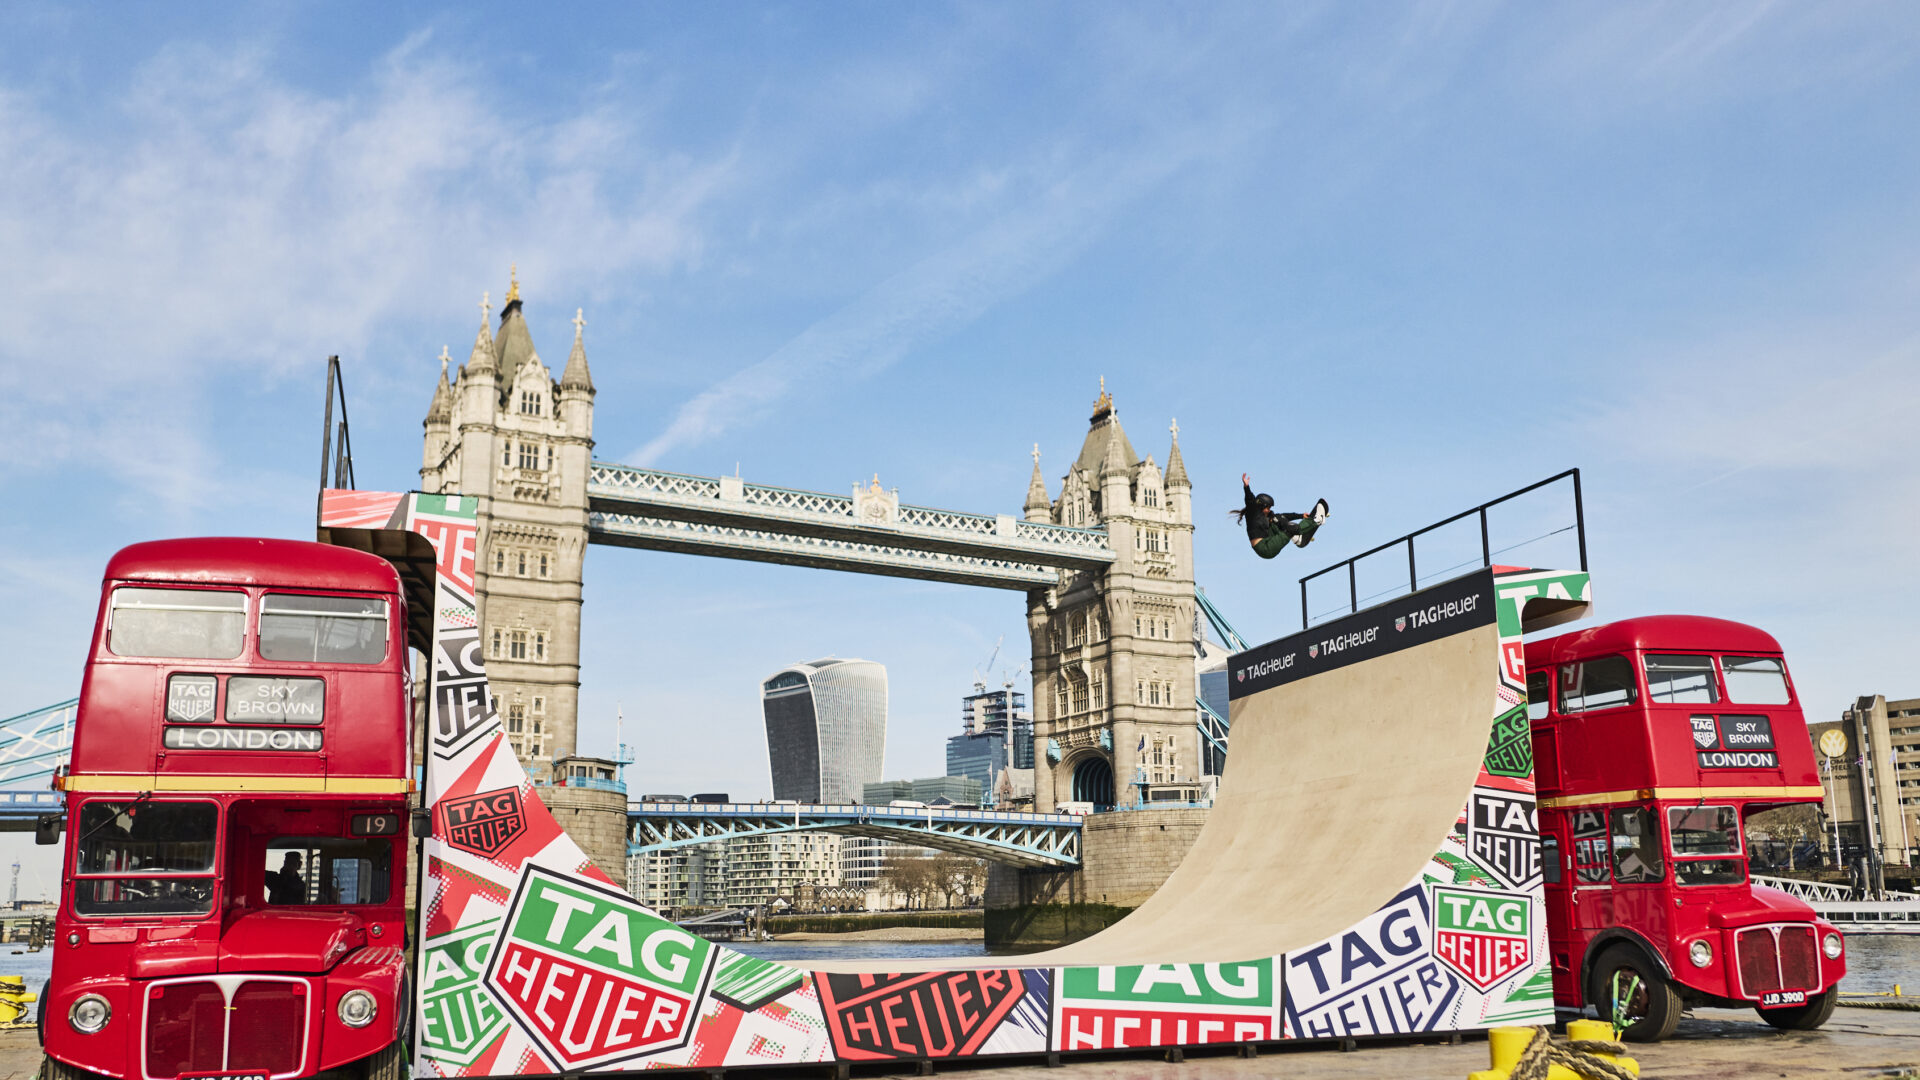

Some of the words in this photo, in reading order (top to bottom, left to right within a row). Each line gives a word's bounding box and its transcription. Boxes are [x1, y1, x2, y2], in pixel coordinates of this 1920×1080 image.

[1408, 593, 1480, 629] TAGHeuer
[1320, 626, 1380, 656] TAGHeuer
[1246, 652, 1296, 680] TAGHeuer
[173, 684, 211, 697] TAG
[257, 685, 298, 698] SKY
[171, 699, 211, 719] HEUER
[238, 701, 315, 714] BROWN
[178, 728, 315, 749] LONDON
[1692, 721, 1713, 730] TAG
[1728, 734, 1770, 744] BROWN
[1736, 722, 1756, 732] SKY
[1701, 753, 1773, 767] LONDON
[450, 795, 513, 822] TAG
[366, 816, 386, 832] 19
[453, 817, 518, 850] HEUER
[1443, 896, 1522, 932] TAG
[539, 886, 696, 984] TAG
[1290, 908, 1423, 994] TAG
[1440, 934, 1526, 984] HEUER
[504, 950, 682, 1056] HEUER
[846, 970, 1006, 1057] HEUER
